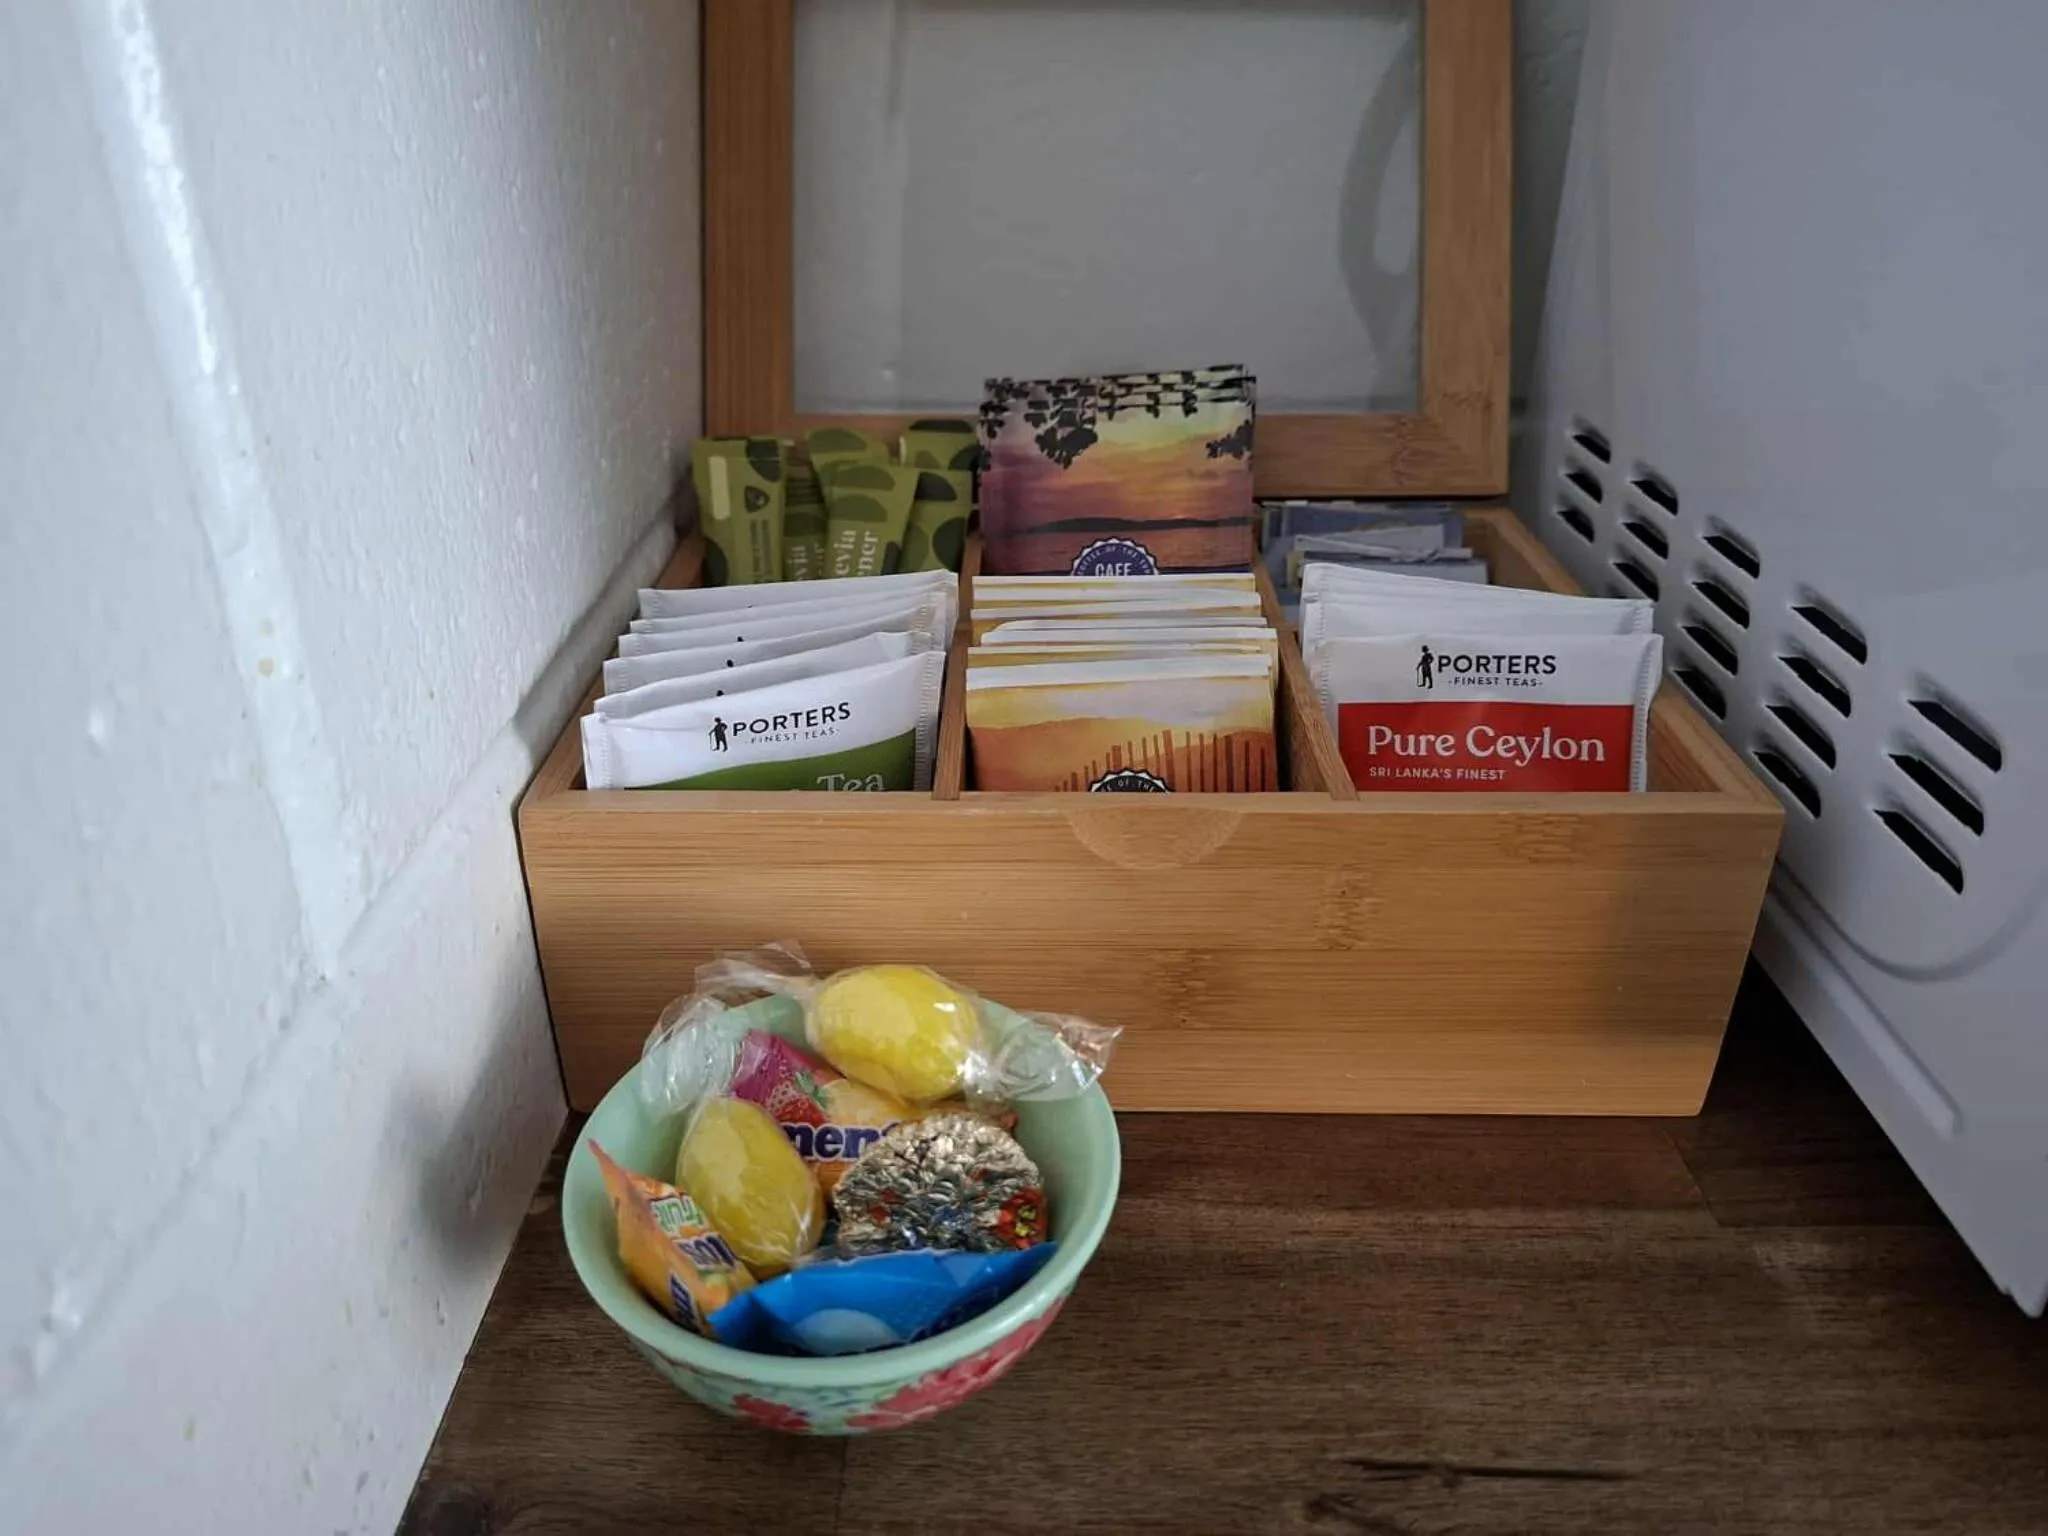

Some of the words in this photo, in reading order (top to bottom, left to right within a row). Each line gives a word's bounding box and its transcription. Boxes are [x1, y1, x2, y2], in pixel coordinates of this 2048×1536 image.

[1437, 655, 1557, 675] PORTERS
[732, 702, 851, 737] PORTERS
[1368, 725, 1456, 757] Pure
[1466, 725, 1606, 767] Ceylon
[816, 773, 884, 793] Tea
[1369, 766, 1391, 778] SRI
[1395, 767, 1452, 779] LANKA'S
[1456, 768, 1507, 780] FINEST
